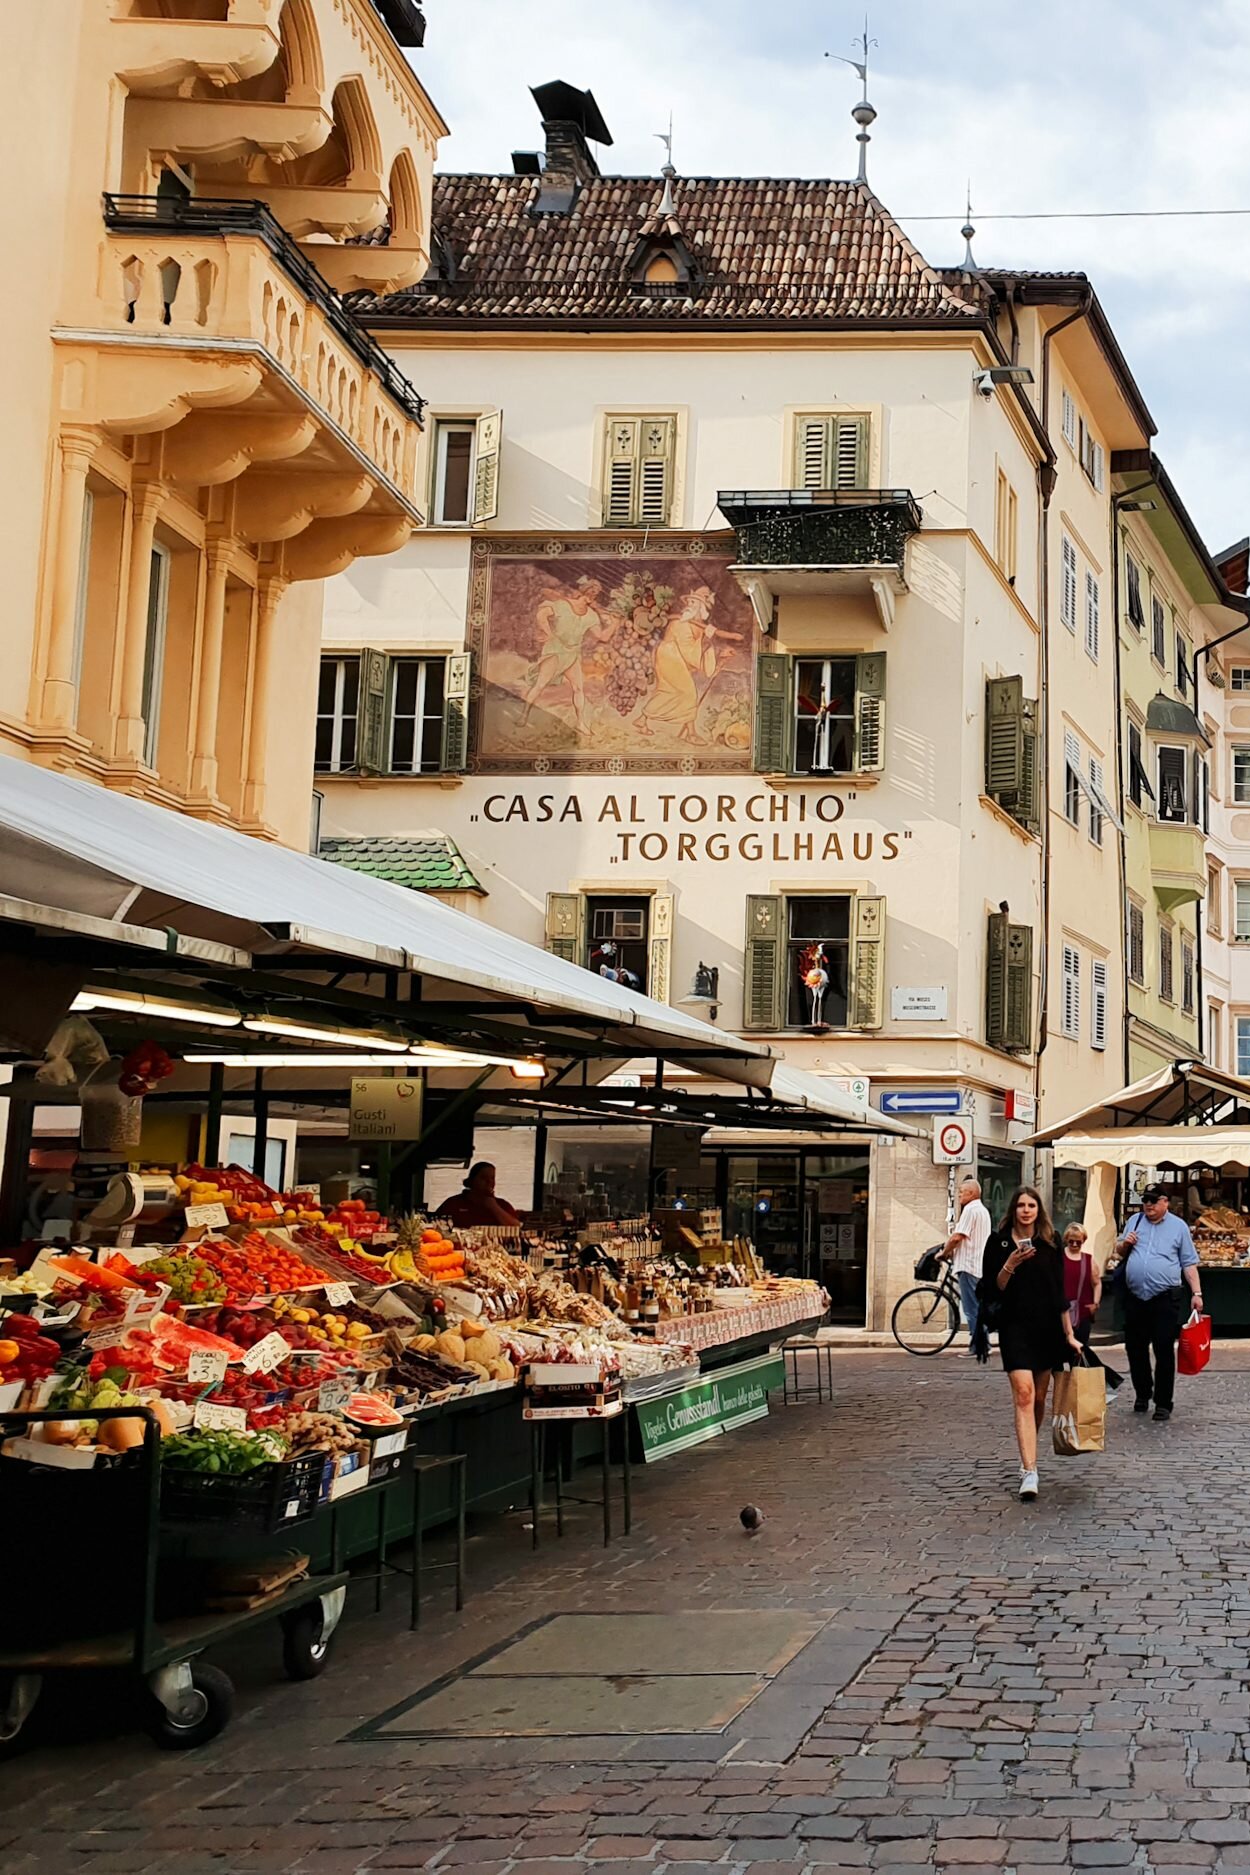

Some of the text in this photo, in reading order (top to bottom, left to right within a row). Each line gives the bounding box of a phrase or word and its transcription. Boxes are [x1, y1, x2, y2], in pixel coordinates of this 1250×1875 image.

[598, 795, 645, 822] AL
[353, 1109, 386, 1120] Gusti
[353, 1123, 396, 1135] Italiani
